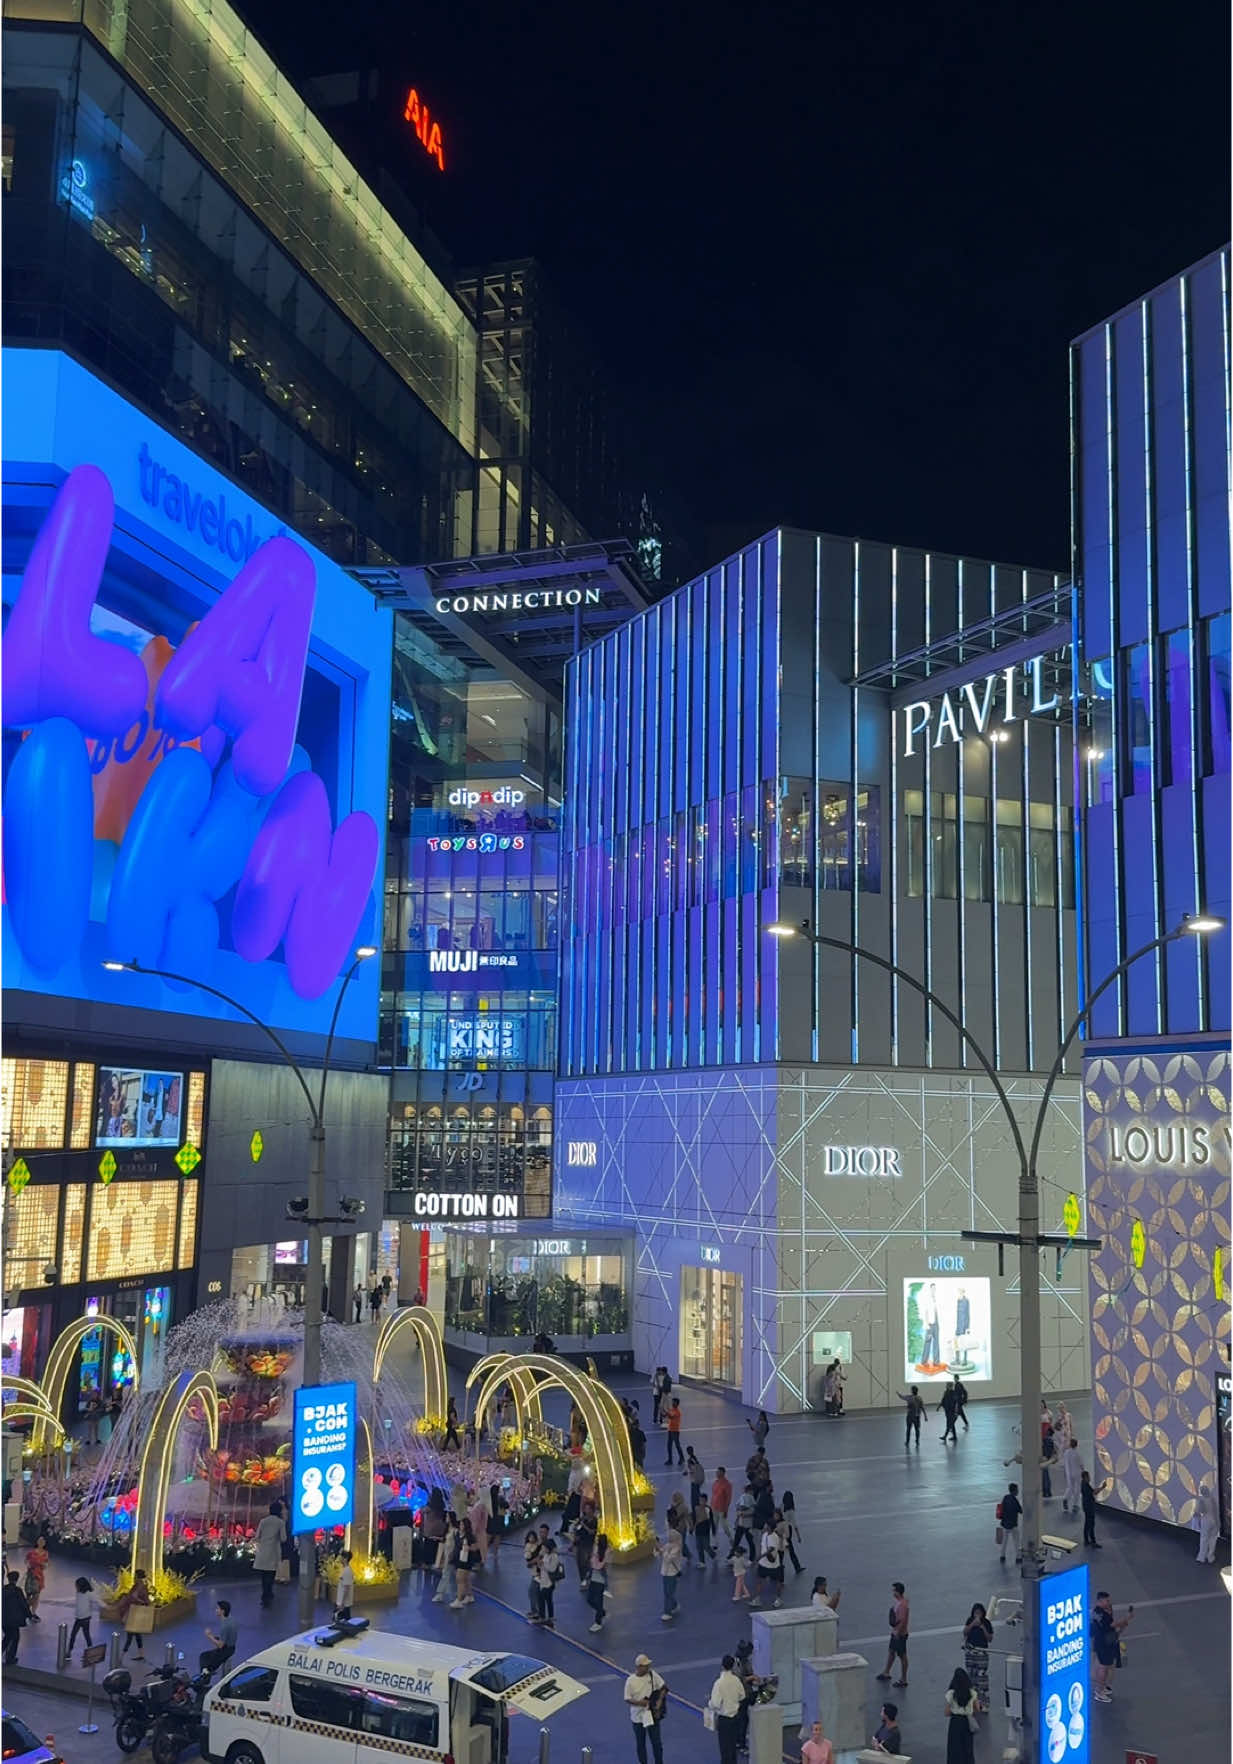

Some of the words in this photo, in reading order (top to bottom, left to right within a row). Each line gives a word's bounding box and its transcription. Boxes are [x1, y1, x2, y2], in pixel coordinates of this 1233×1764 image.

[404, 88, 445, 172] AIA
[138, 441, 287, 566] travelok
[435, 588, 601, 614] CONNECTION
[430, 950, 478, 972] MUJI
[567, 1142, 597, 1166] DIOR
[1110, 1126, 1210, 1167] LOUIS
[823, 1145, 903, 1177] DIOR
[414, 1192, 488, 1216] COTTON
[492, 1194, 519, 1217] ON
[534, 1240, 572, 1255] DIOR
[927, 1255, 965, 1271] DIOR
[303, 1403, 348, 1420] BJAK
[1047, 1594, 1083, 1624] BJAK
[1047, 1637, 1084, 1664] BANDING
[288, 1653, 323, 1672] BALAI
[326, 1660, 362, 1681] POLIS
[365, 1668, 433, 1696] BERGERAK
